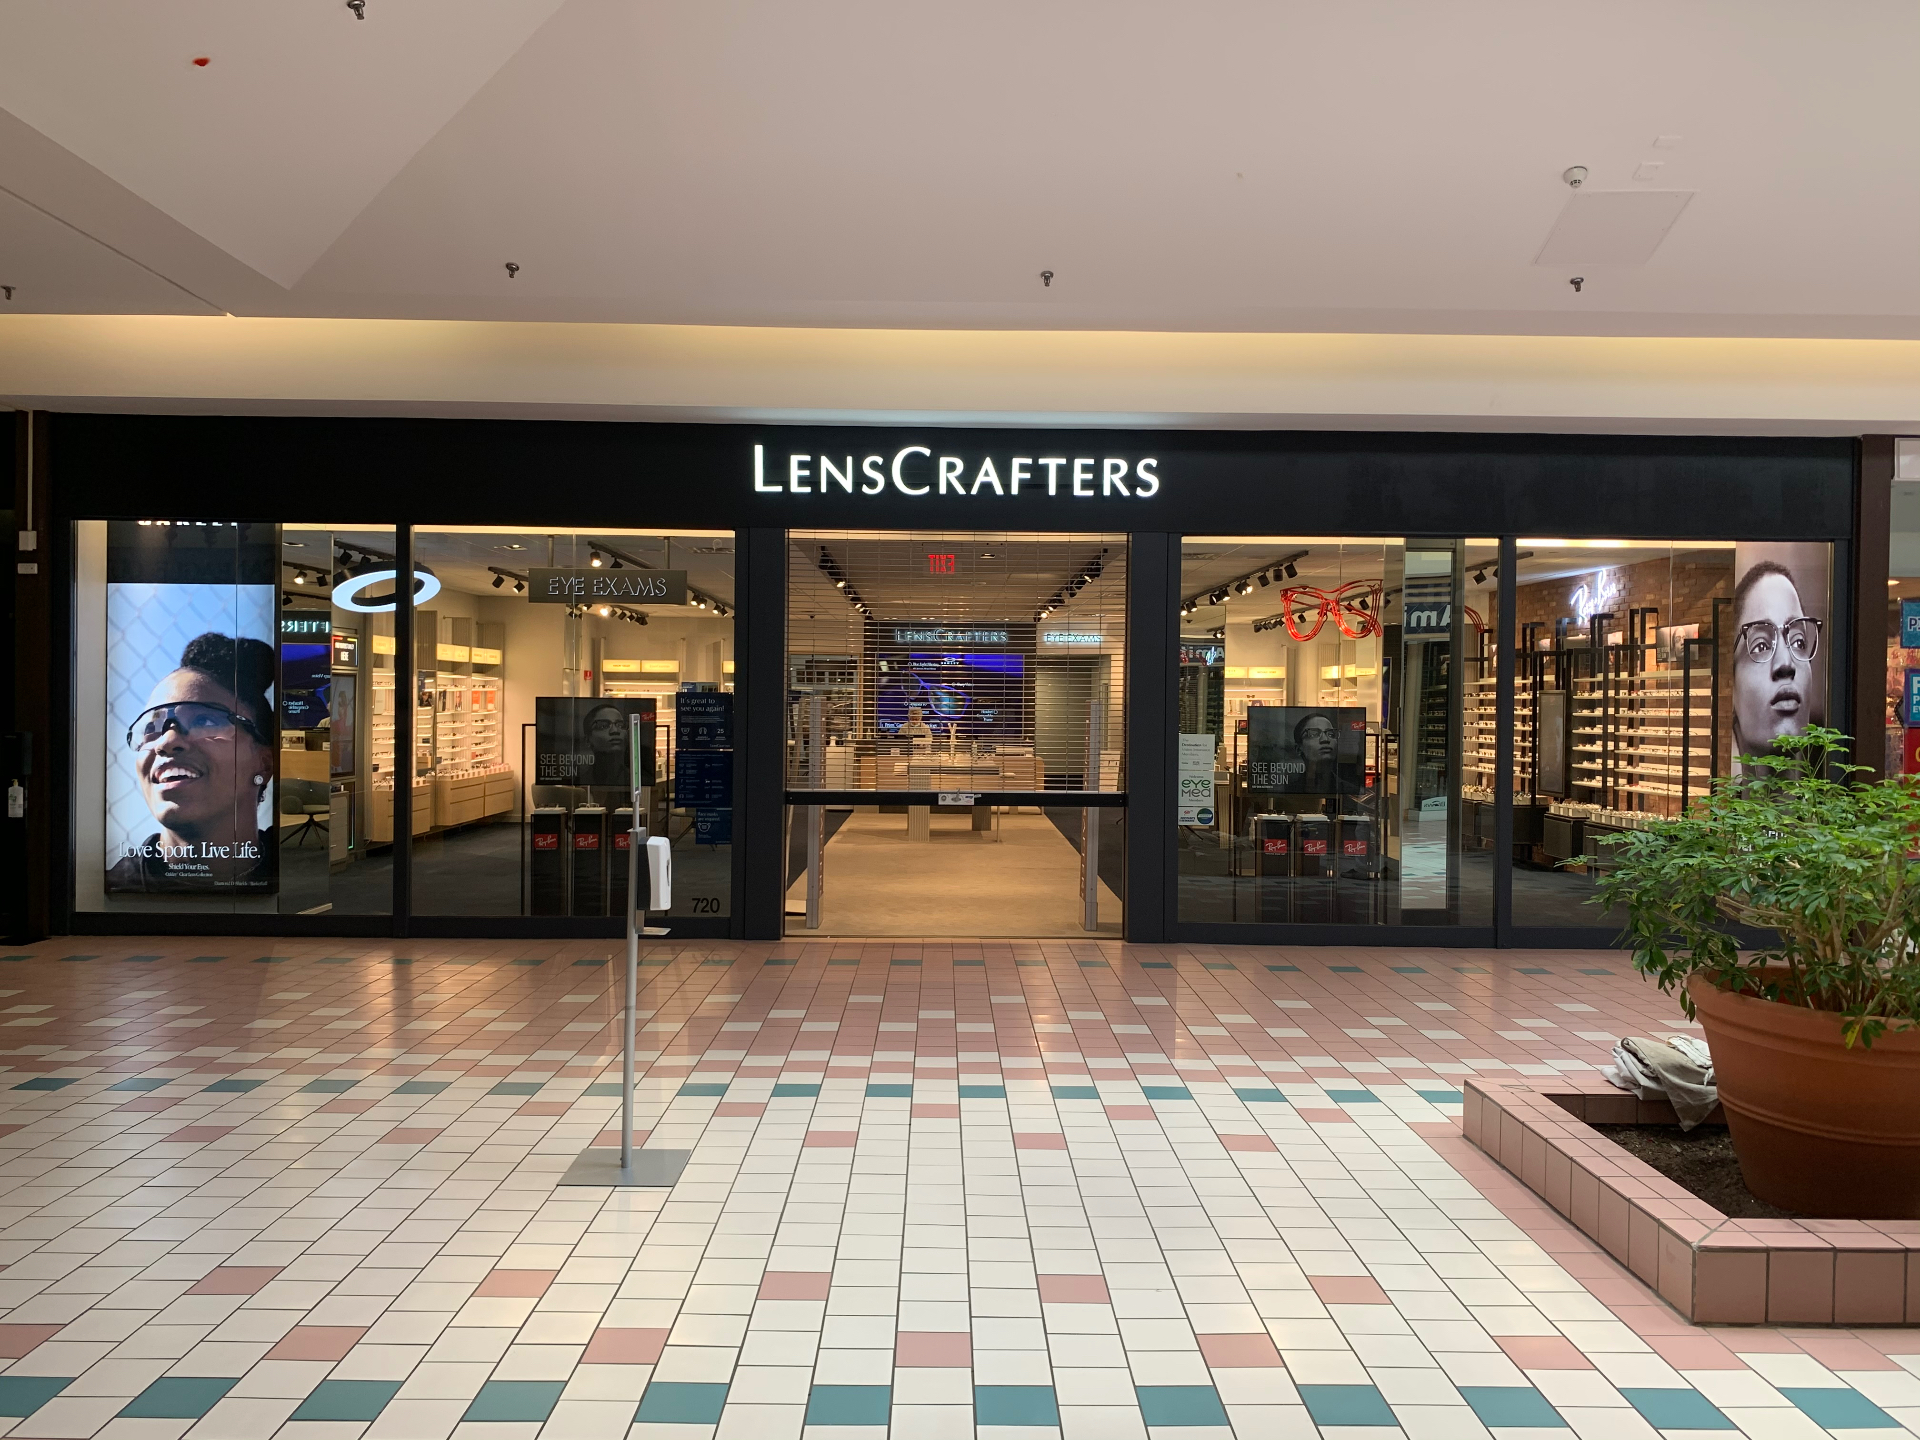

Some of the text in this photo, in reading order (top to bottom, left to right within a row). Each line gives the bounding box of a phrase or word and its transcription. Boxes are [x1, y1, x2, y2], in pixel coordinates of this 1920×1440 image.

[753, 444, 1160, 497] LENSCRAFTERS
[548, 577, 667, 597] EYE EXAMS
[1045, 633, 1064, 643] EYE
[691, 698, 707, 706] great
[705, 704, 725, 713] again!
[539, 753, 595, 765] SEE BEYOND
[540, 765, 578, 777] THE SUN
[1251, 761, 1306, 774] SEE BEYOND
[1252, 773, 1289, 785] THE SUN
[118, 841, 261, 863] Love Sport. Live Life.
[197, 863, 210, 872] Eyes.
[691, 897, 721, 914] 720
